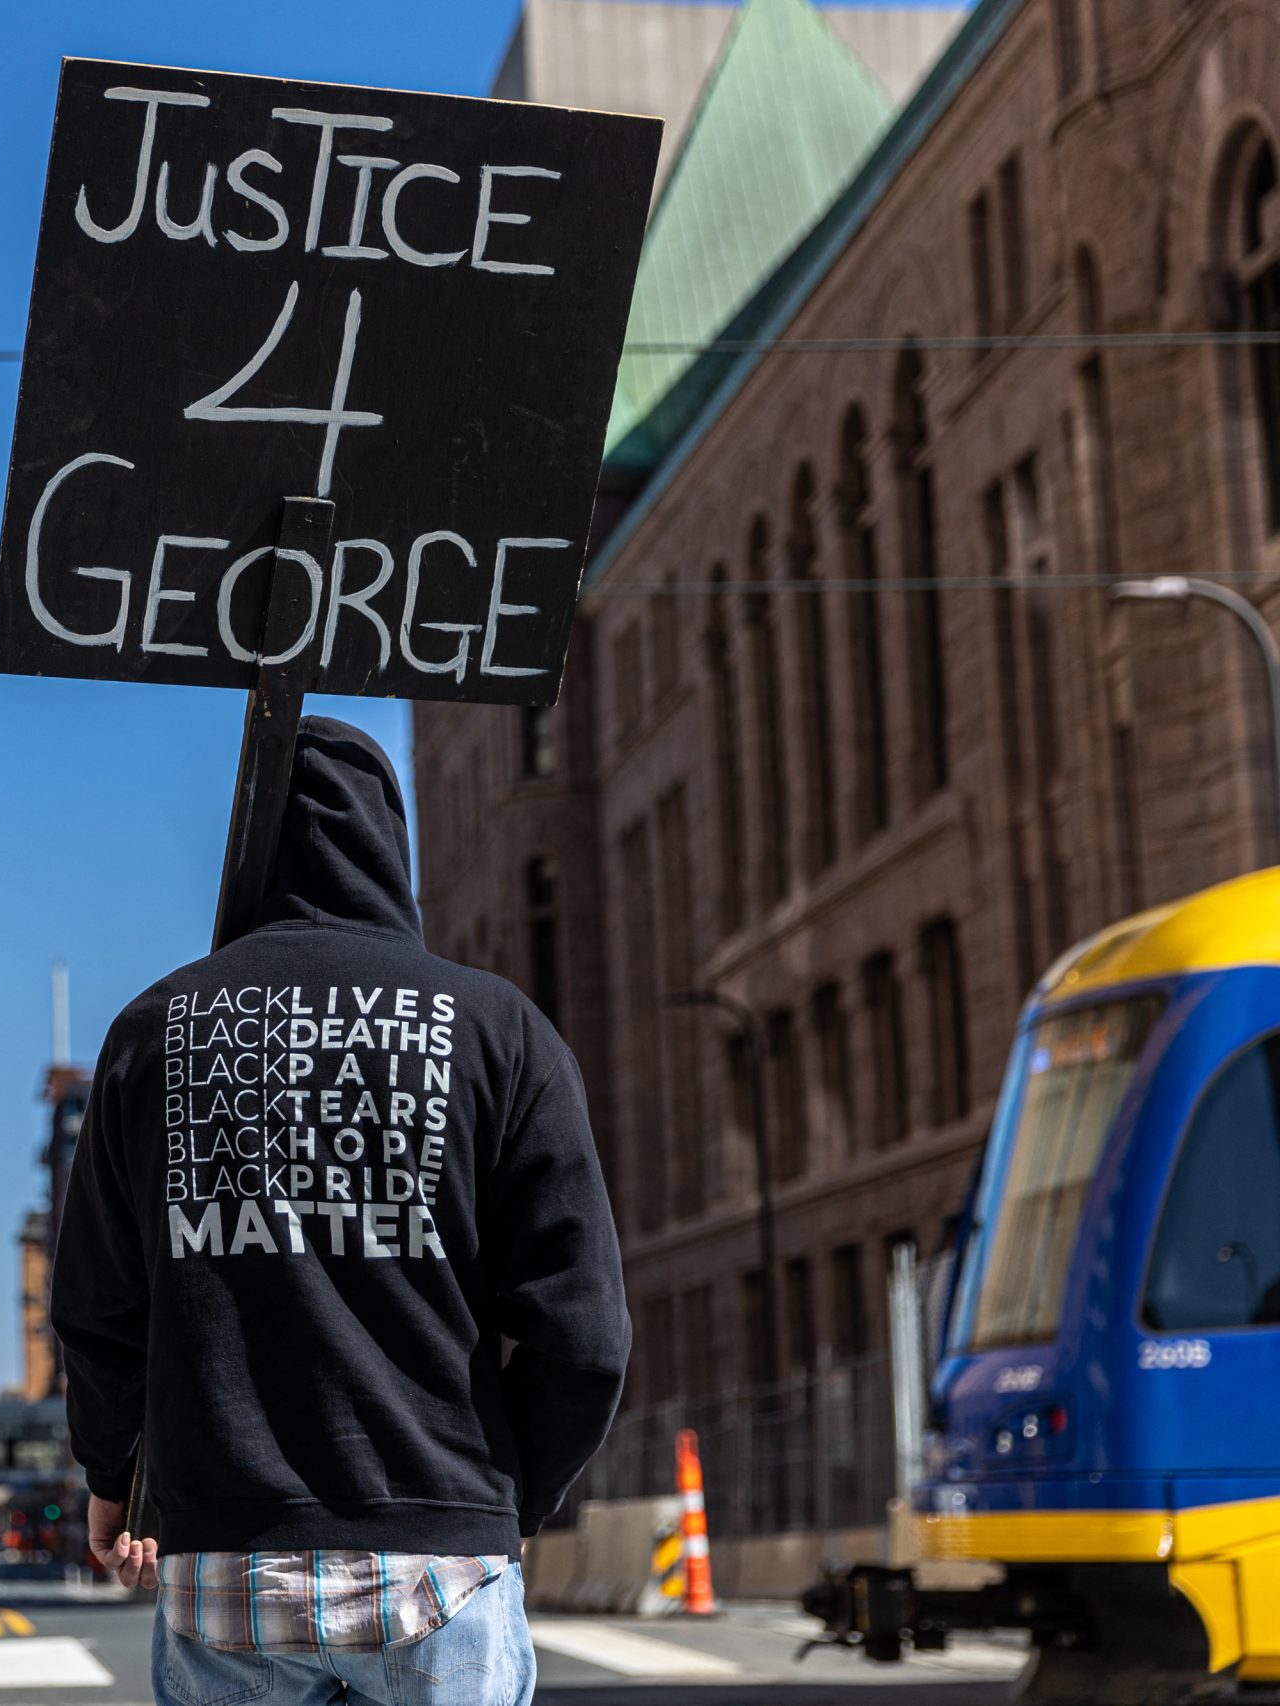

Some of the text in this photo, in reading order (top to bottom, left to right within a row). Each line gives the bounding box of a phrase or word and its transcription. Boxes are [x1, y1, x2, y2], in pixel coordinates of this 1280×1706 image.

[183, 280, 383, 497] 4
[25, 452, 574, 683] GEORGE
[168, 1200, 447, 1259] MATTER
